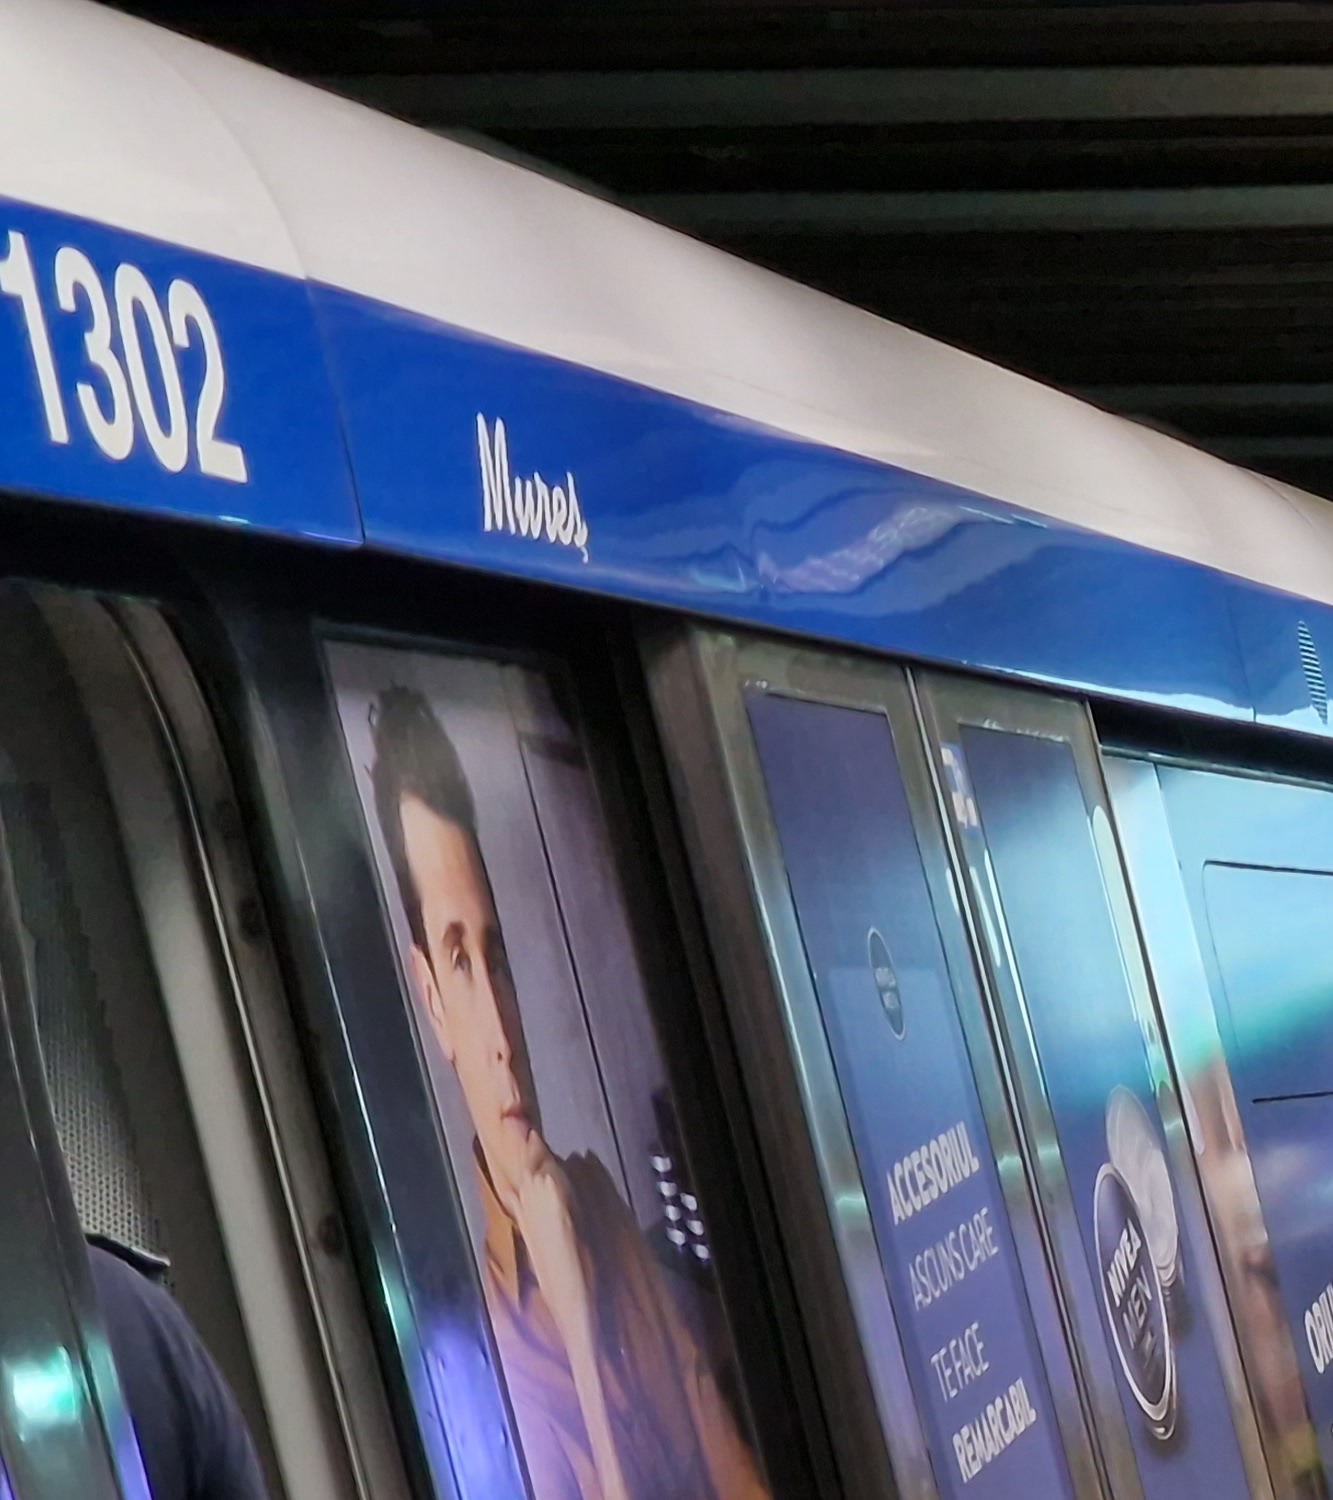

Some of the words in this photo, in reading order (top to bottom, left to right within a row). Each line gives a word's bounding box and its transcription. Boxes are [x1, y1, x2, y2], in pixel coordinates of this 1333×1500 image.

[0, 230, 249, 483] 1302
[886, 1120, 980, 1226] ACCESORIUL
[908, 1230, 966, 1313] ASCUNS
[959, 1206, 999, 1272] CARE
[930, 1346, 959, 1402] TE
[949, 1321, 990, 1390] FACE
[952, 1377, 1037, 1484] REMARCABIL
